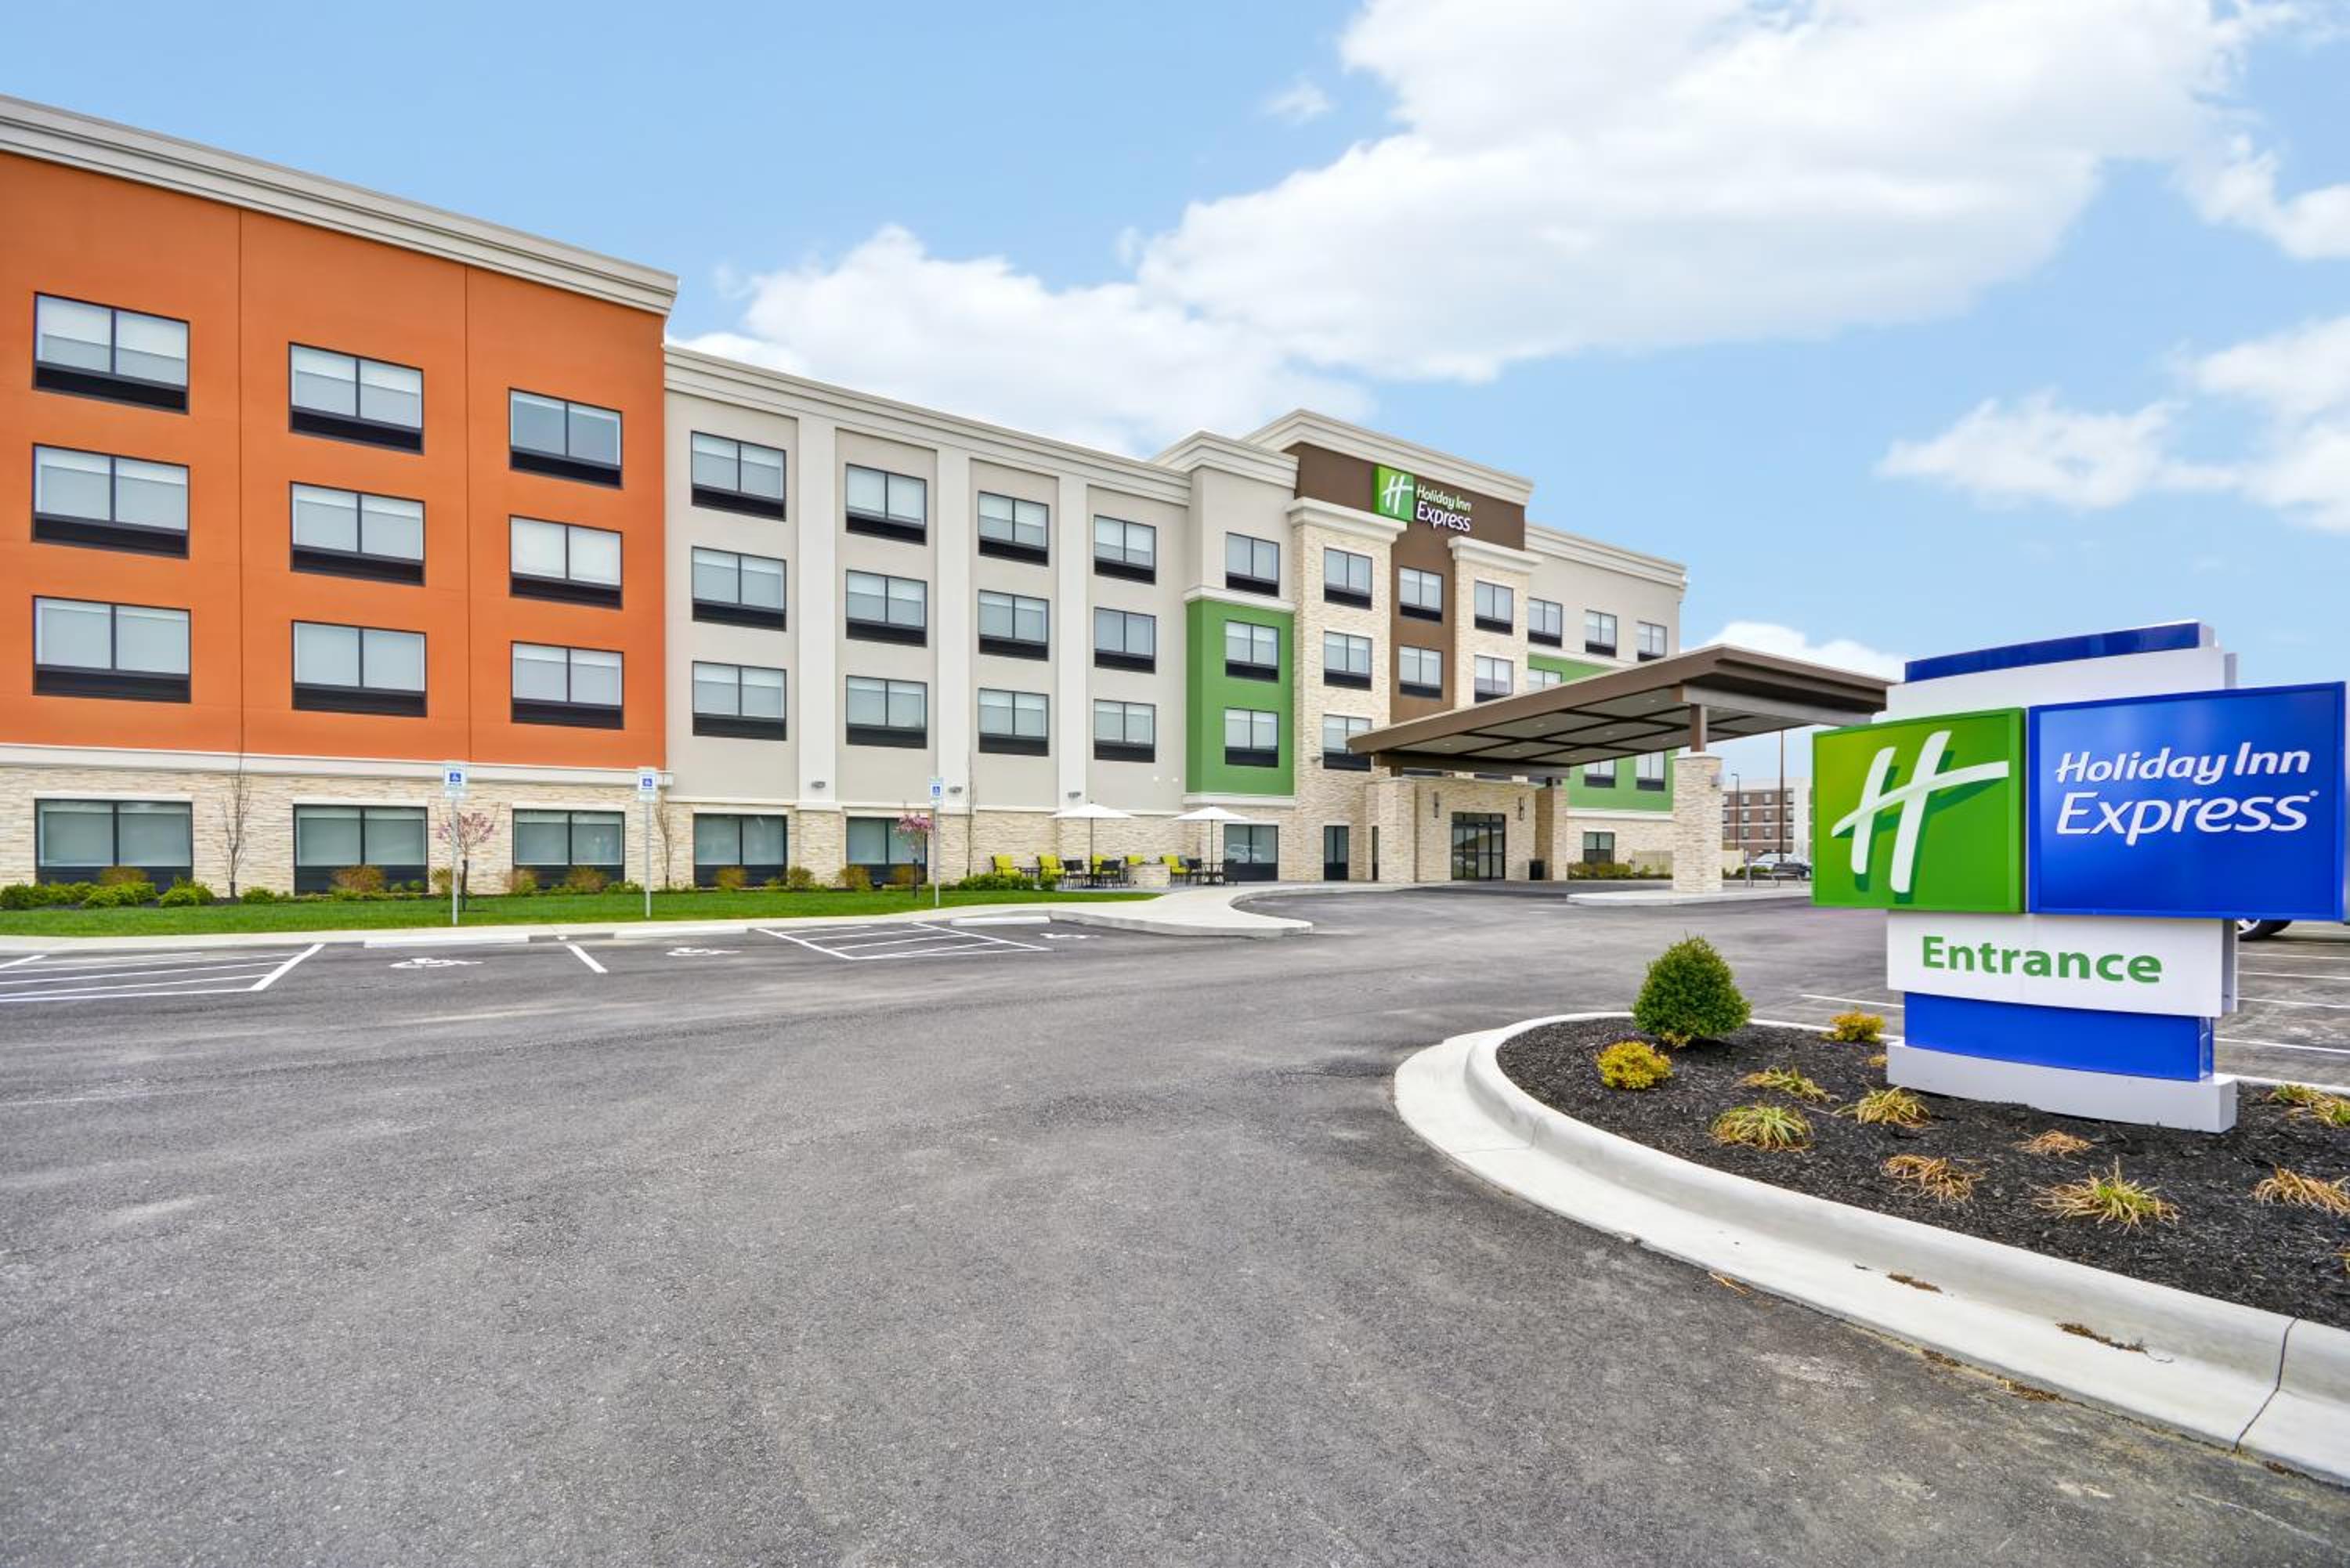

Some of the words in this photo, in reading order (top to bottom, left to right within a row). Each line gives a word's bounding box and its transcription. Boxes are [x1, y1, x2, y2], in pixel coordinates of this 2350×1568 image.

[1416, 484, 1455, 510] Holiday
[1456, 496, 1472, 512] Inn
[1416, 500, 1472, 532] Express
[2055, 747, 2227, 786] Holiday
[2234, 742, 2310, 776] Inn
[1831, 729, 2009, 894] H
[2056, 791, 2311, 846] Express
[1922, 936, 2162, 983] Entrance
